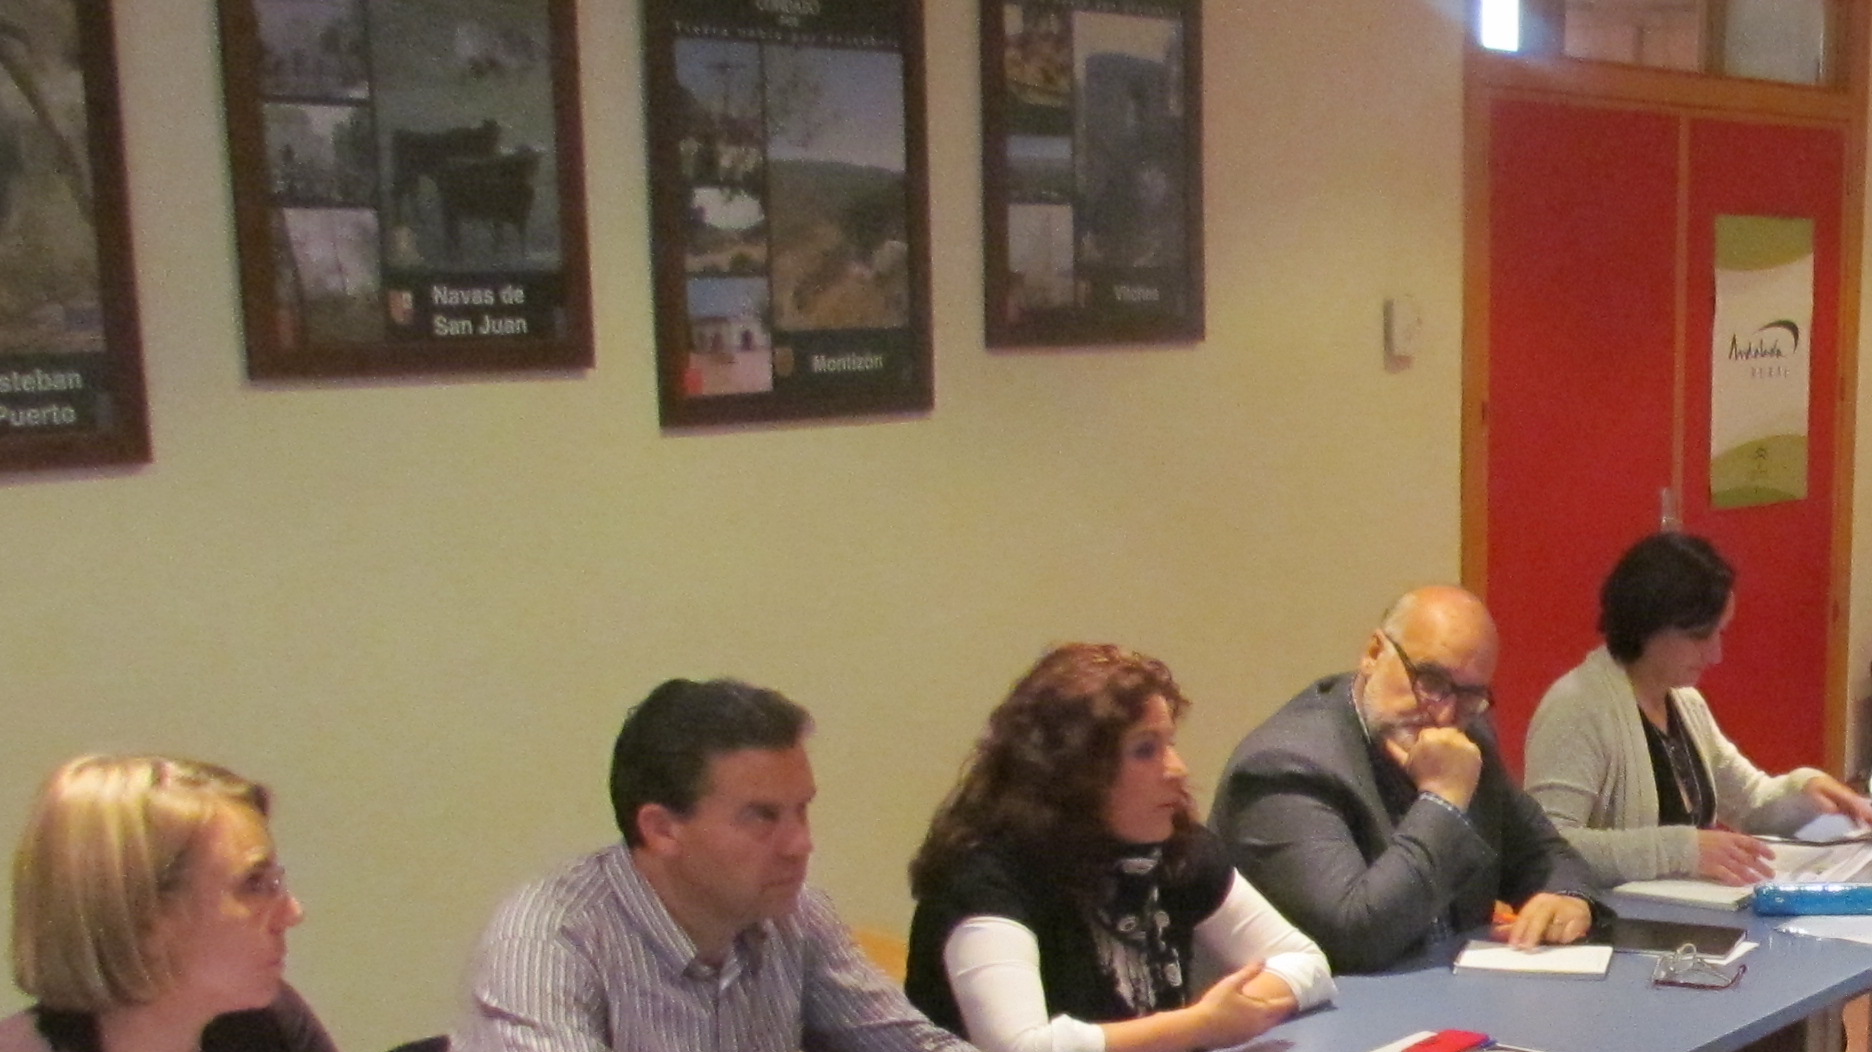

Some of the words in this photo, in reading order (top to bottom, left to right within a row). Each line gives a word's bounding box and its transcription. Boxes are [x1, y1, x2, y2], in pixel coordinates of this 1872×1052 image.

[432, 284, 494, 306] Navas
[499, 284, 526, 305] de
[432, 313, 474, 337] San
[479, 313, 528, 336] Juan
[0, 367, 83, 394] steban
